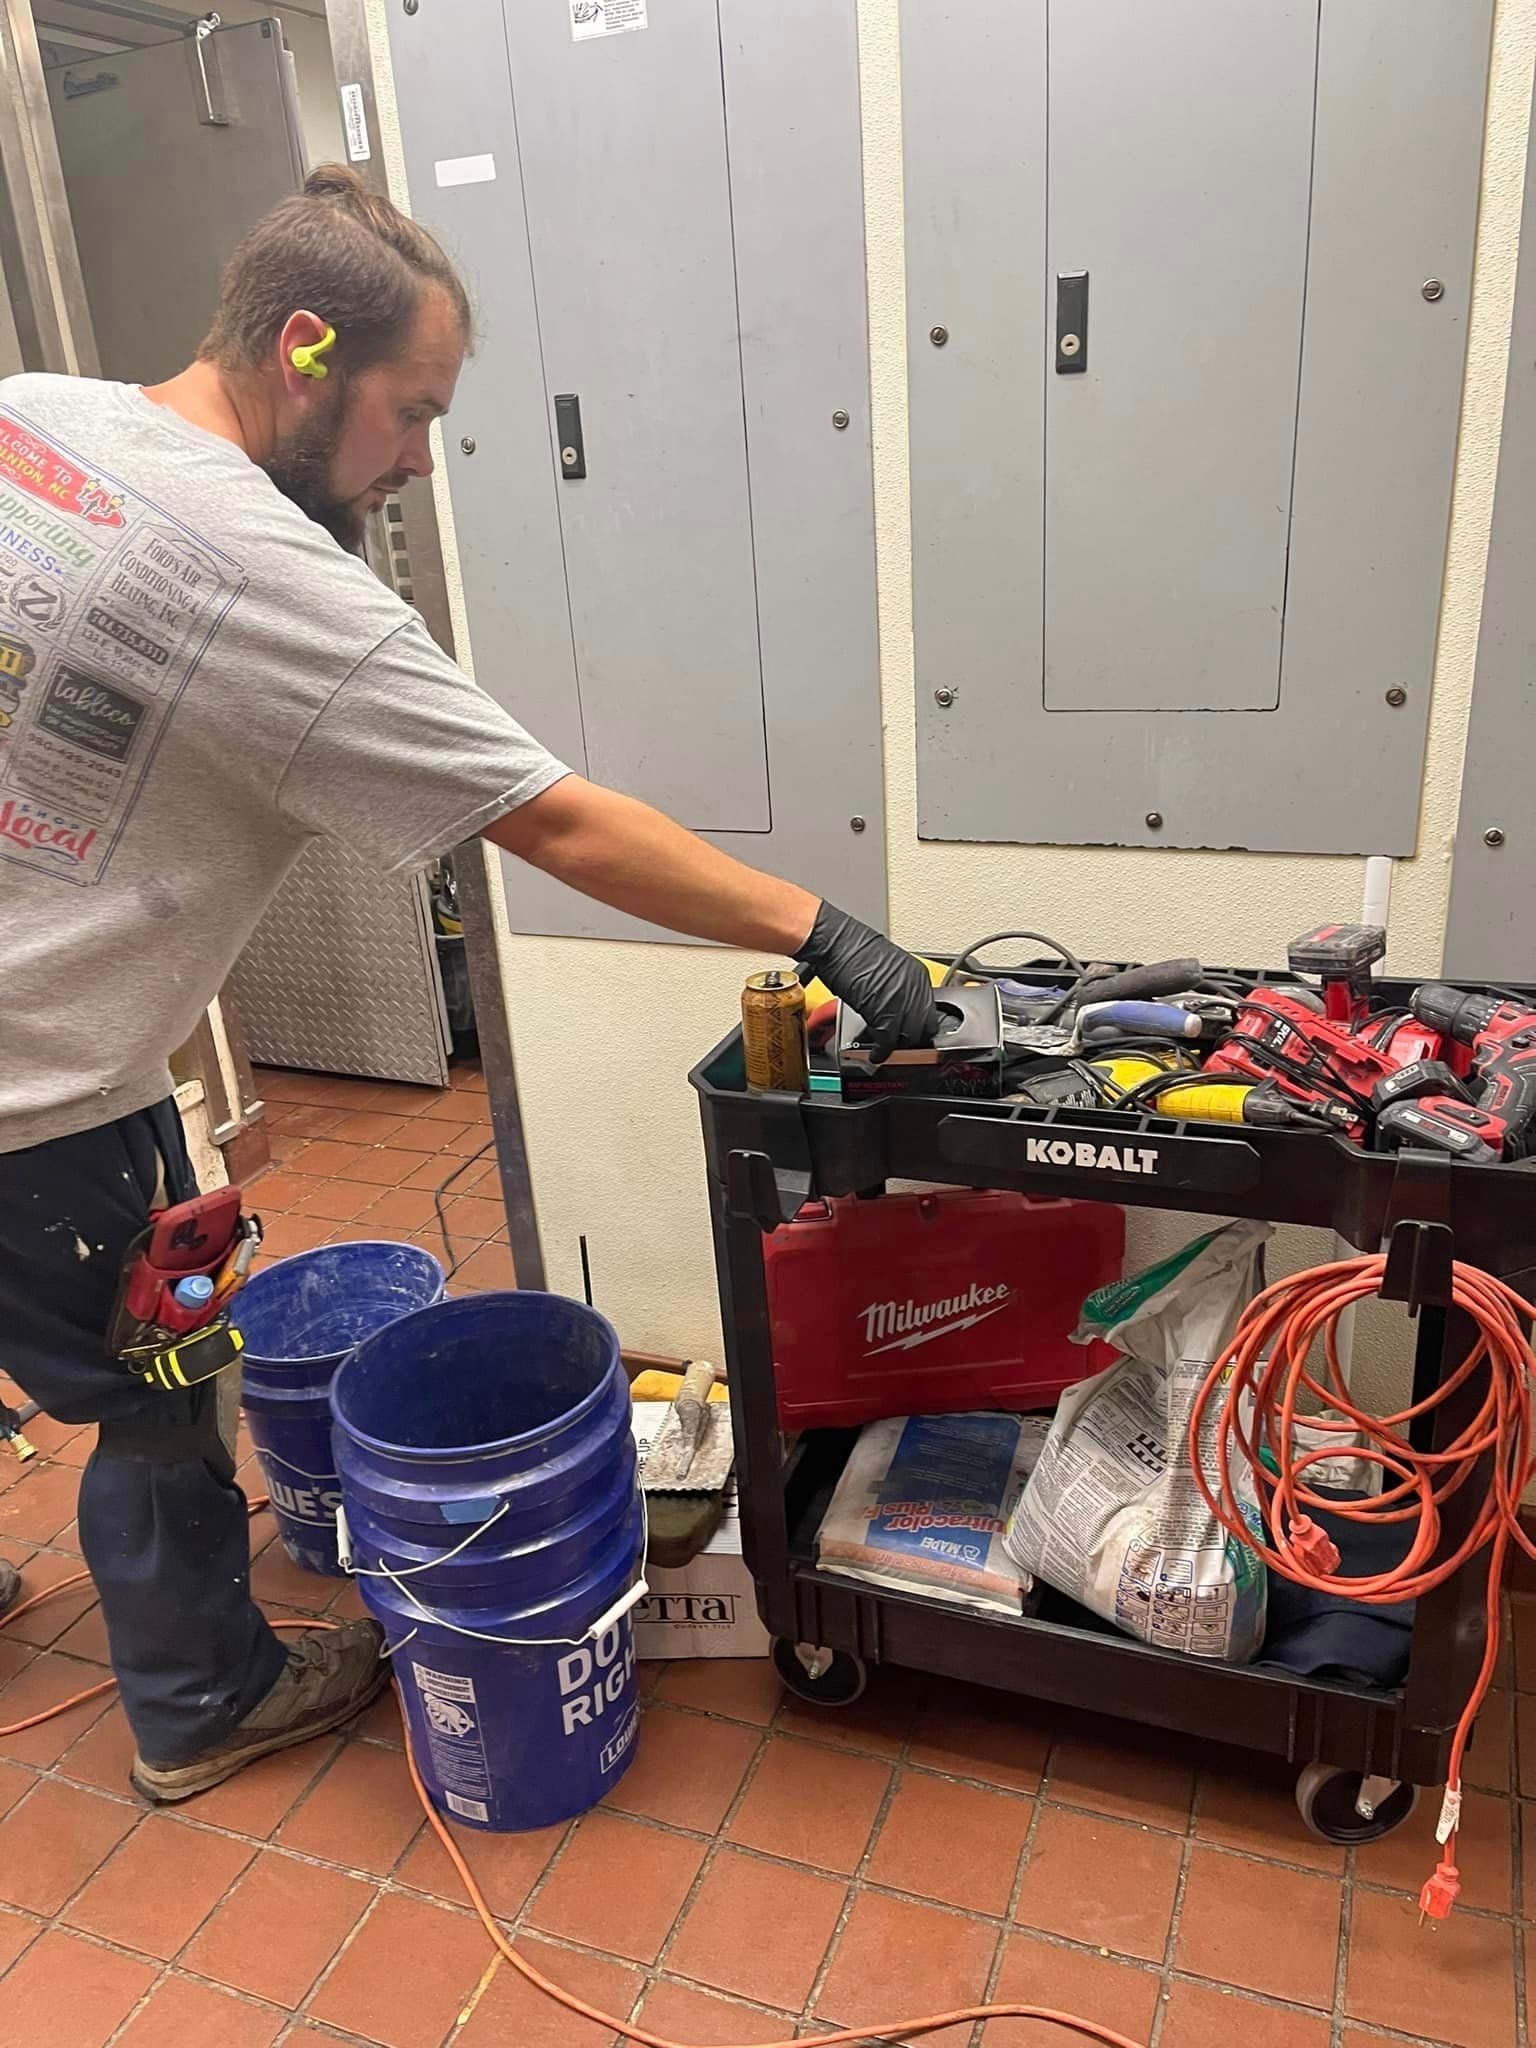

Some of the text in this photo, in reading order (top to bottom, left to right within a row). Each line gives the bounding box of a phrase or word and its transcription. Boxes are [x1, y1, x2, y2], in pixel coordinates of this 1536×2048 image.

[0, 428, 73, 486] LCOME TO
[49, 482, 70, 500] NC
[0, 494, 97, 568] pporting
[179, 564, 202, 589] AIR
[1026, 1138, 1159, 1175] KOBALT
[856, 1283, 1011, 1343] Milwaukee
[882, 1501, 933, 1516] Plus
[882, 1514, 1007, 1535] Ultracolor
[920, 1536, 963, 1555] MAPEI
[557, 1622, 620, 1697] DO
